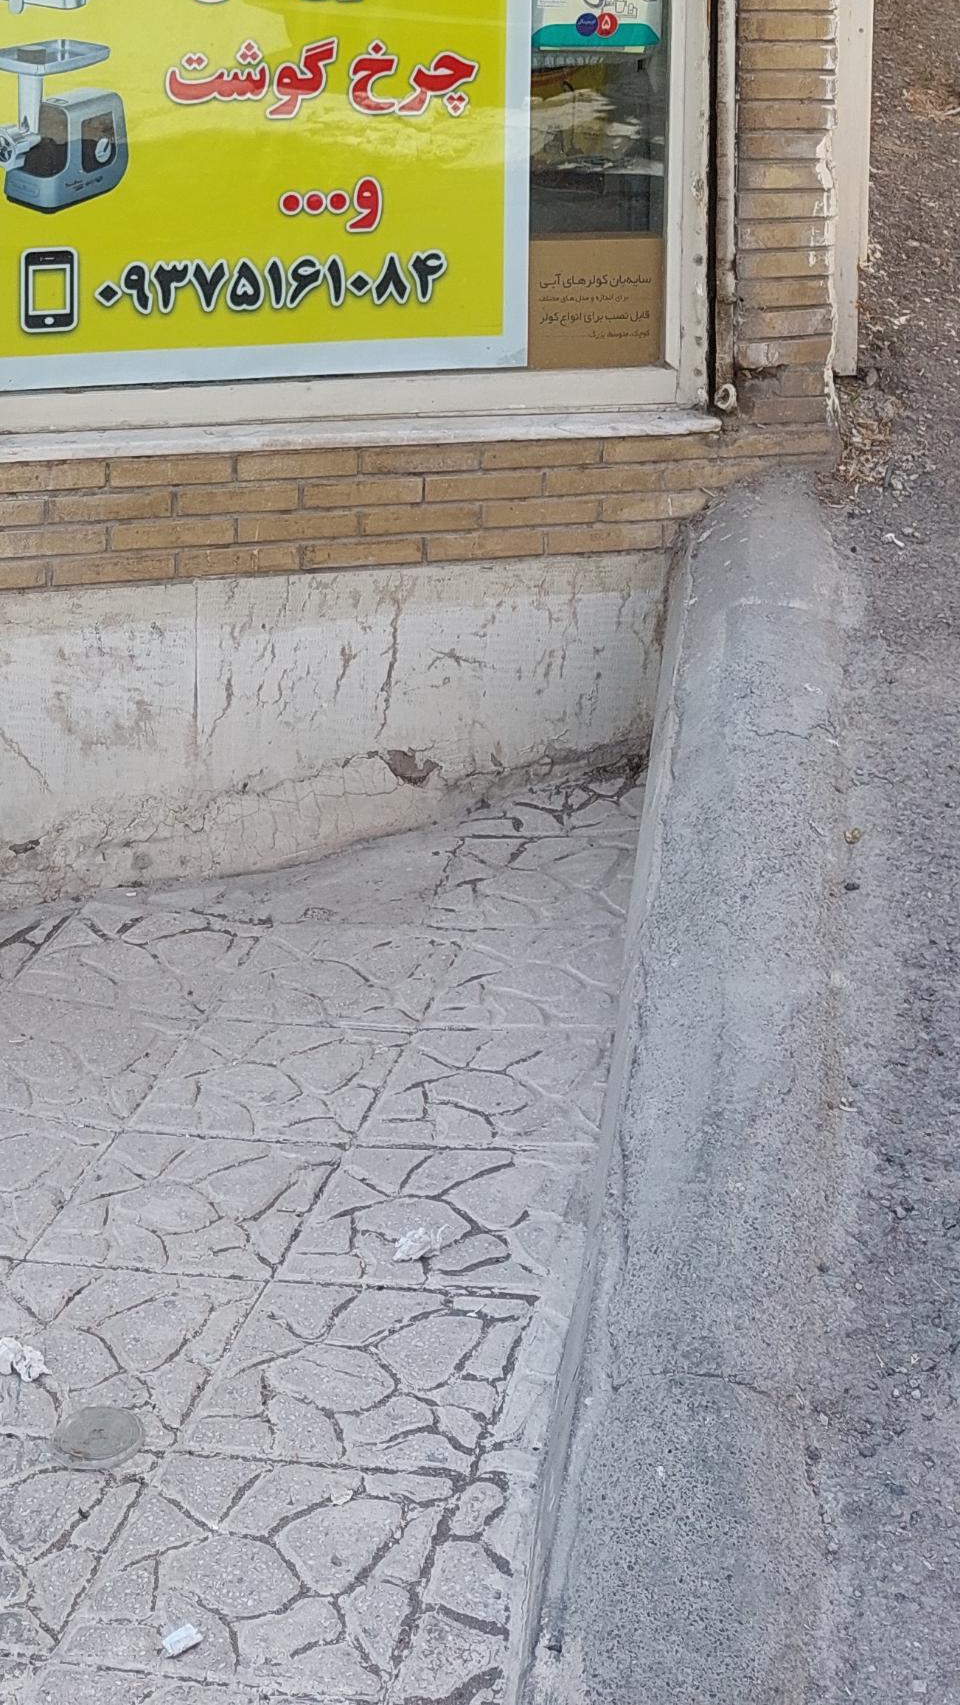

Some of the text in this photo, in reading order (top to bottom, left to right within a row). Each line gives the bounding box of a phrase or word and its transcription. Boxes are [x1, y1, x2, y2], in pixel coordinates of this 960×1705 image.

[165, 39, 478, 119] چرخ گوشت
[95, 249, 447, 315] ۰۹۳۷۵۱۶۱۰۸۴
